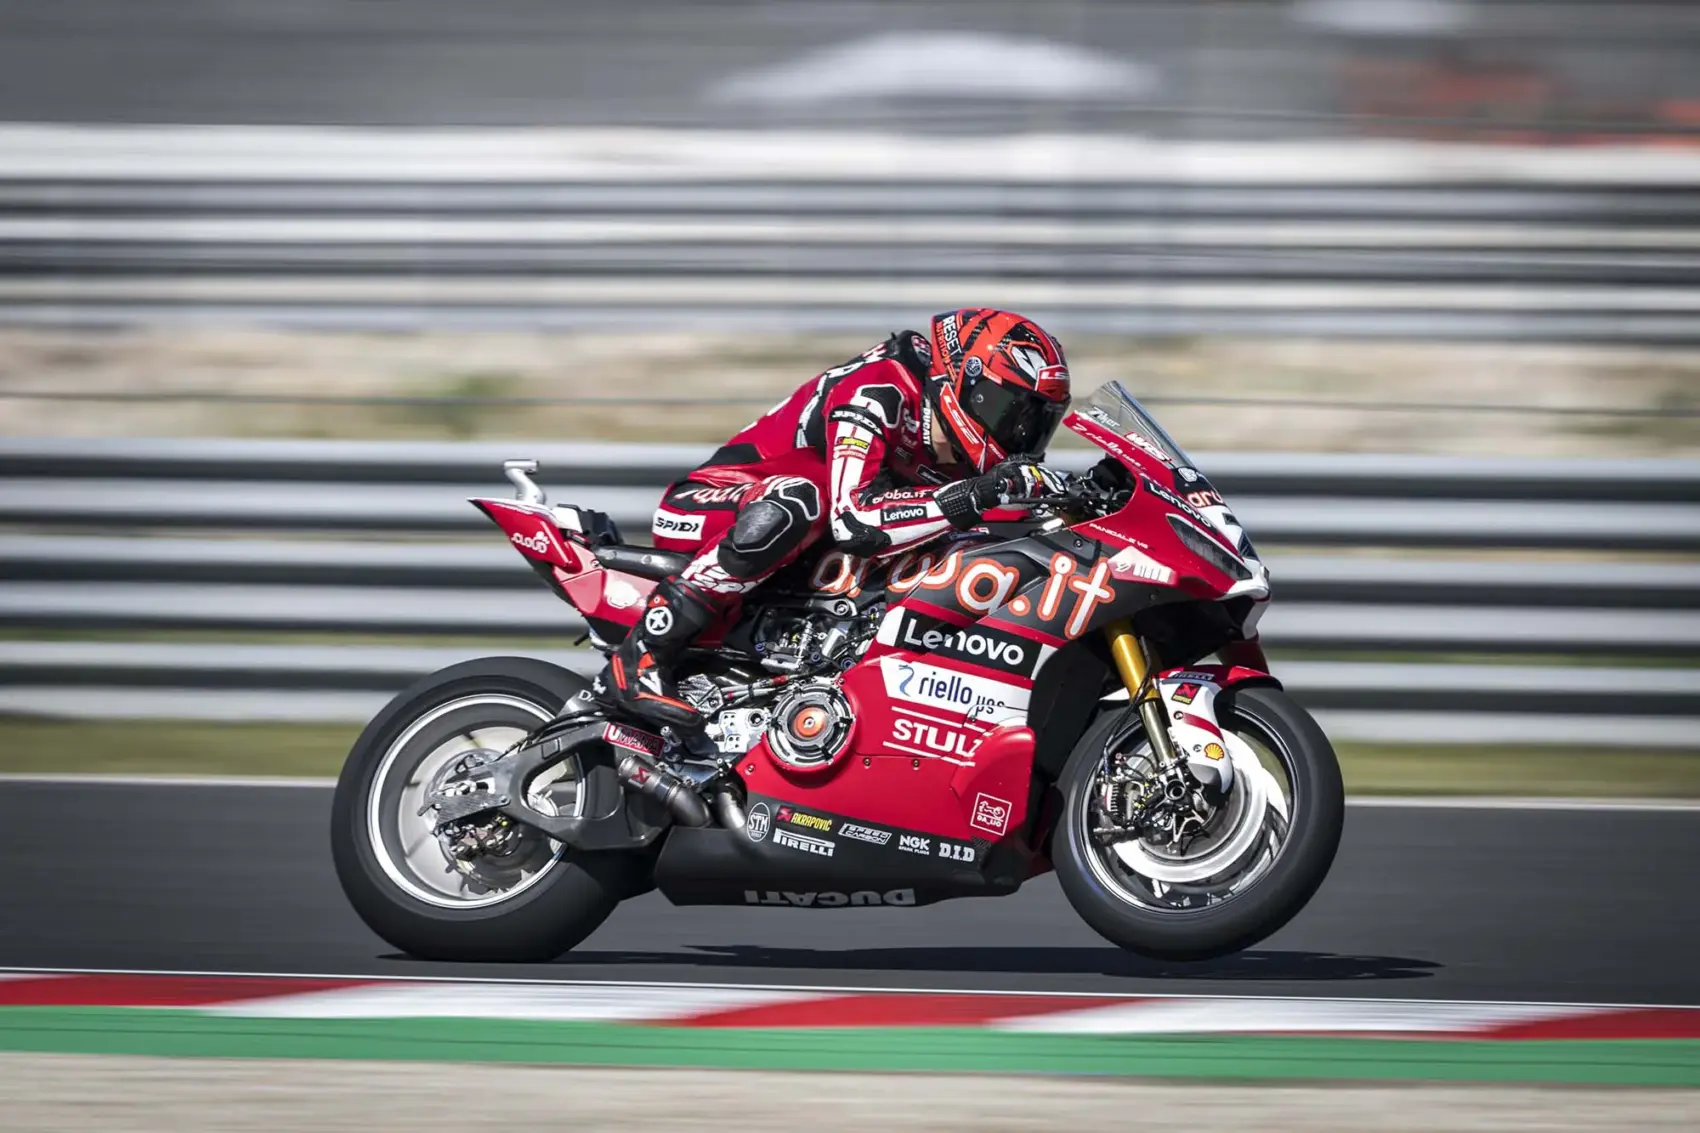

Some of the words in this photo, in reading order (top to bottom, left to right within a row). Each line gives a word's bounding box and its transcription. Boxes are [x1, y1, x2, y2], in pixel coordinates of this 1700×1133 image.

[942, 315, 962, 356] RESET
[922, 407, 932, 445] DUCATI
[883, 508, 924, 522] Lenovo
[1149, 482, 1212, 528] Lenovo
[655, 516, 700, 532] SPIDI
[903, 618, 1024, 666] Lenovo
[918, 671, 972, 705] riello
[748, 814, 768, 832] STM
[773, 828, 835, 857] PIRELLI
[899, 834, 930, 851] NGK
[938, 842, 975, 862] D.I.D
[744, 888, 916, 907] DUCATI
